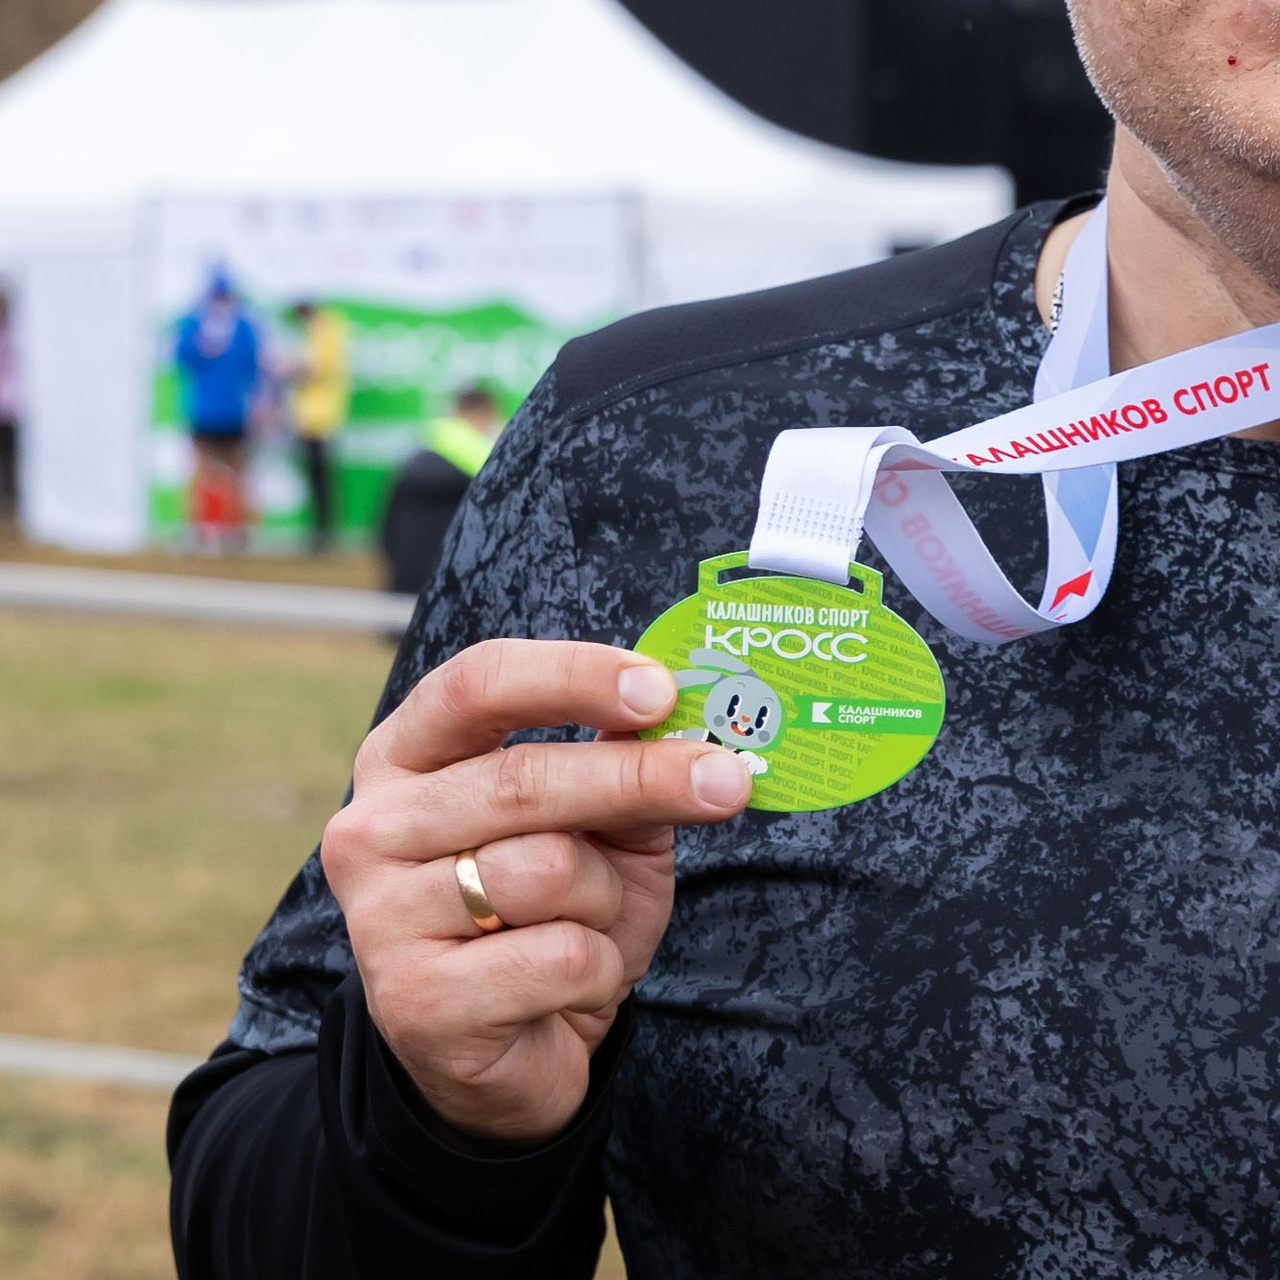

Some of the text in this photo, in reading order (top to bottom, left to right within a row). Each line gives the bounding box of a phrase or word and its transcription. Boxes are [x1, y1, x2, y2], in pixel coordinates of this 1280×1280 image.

[952, 362, 1270, 467] АЛАШНИКОВ СПОРТ
[707, 601, 869, 628] КАЛАШНИКОВ СПОРТ
[705, 624, 869, 663] КРОСС
[838, 705, 923, 719] КАЛАШНИКОВ
[838, 714, 877, 725] СПОРТ
